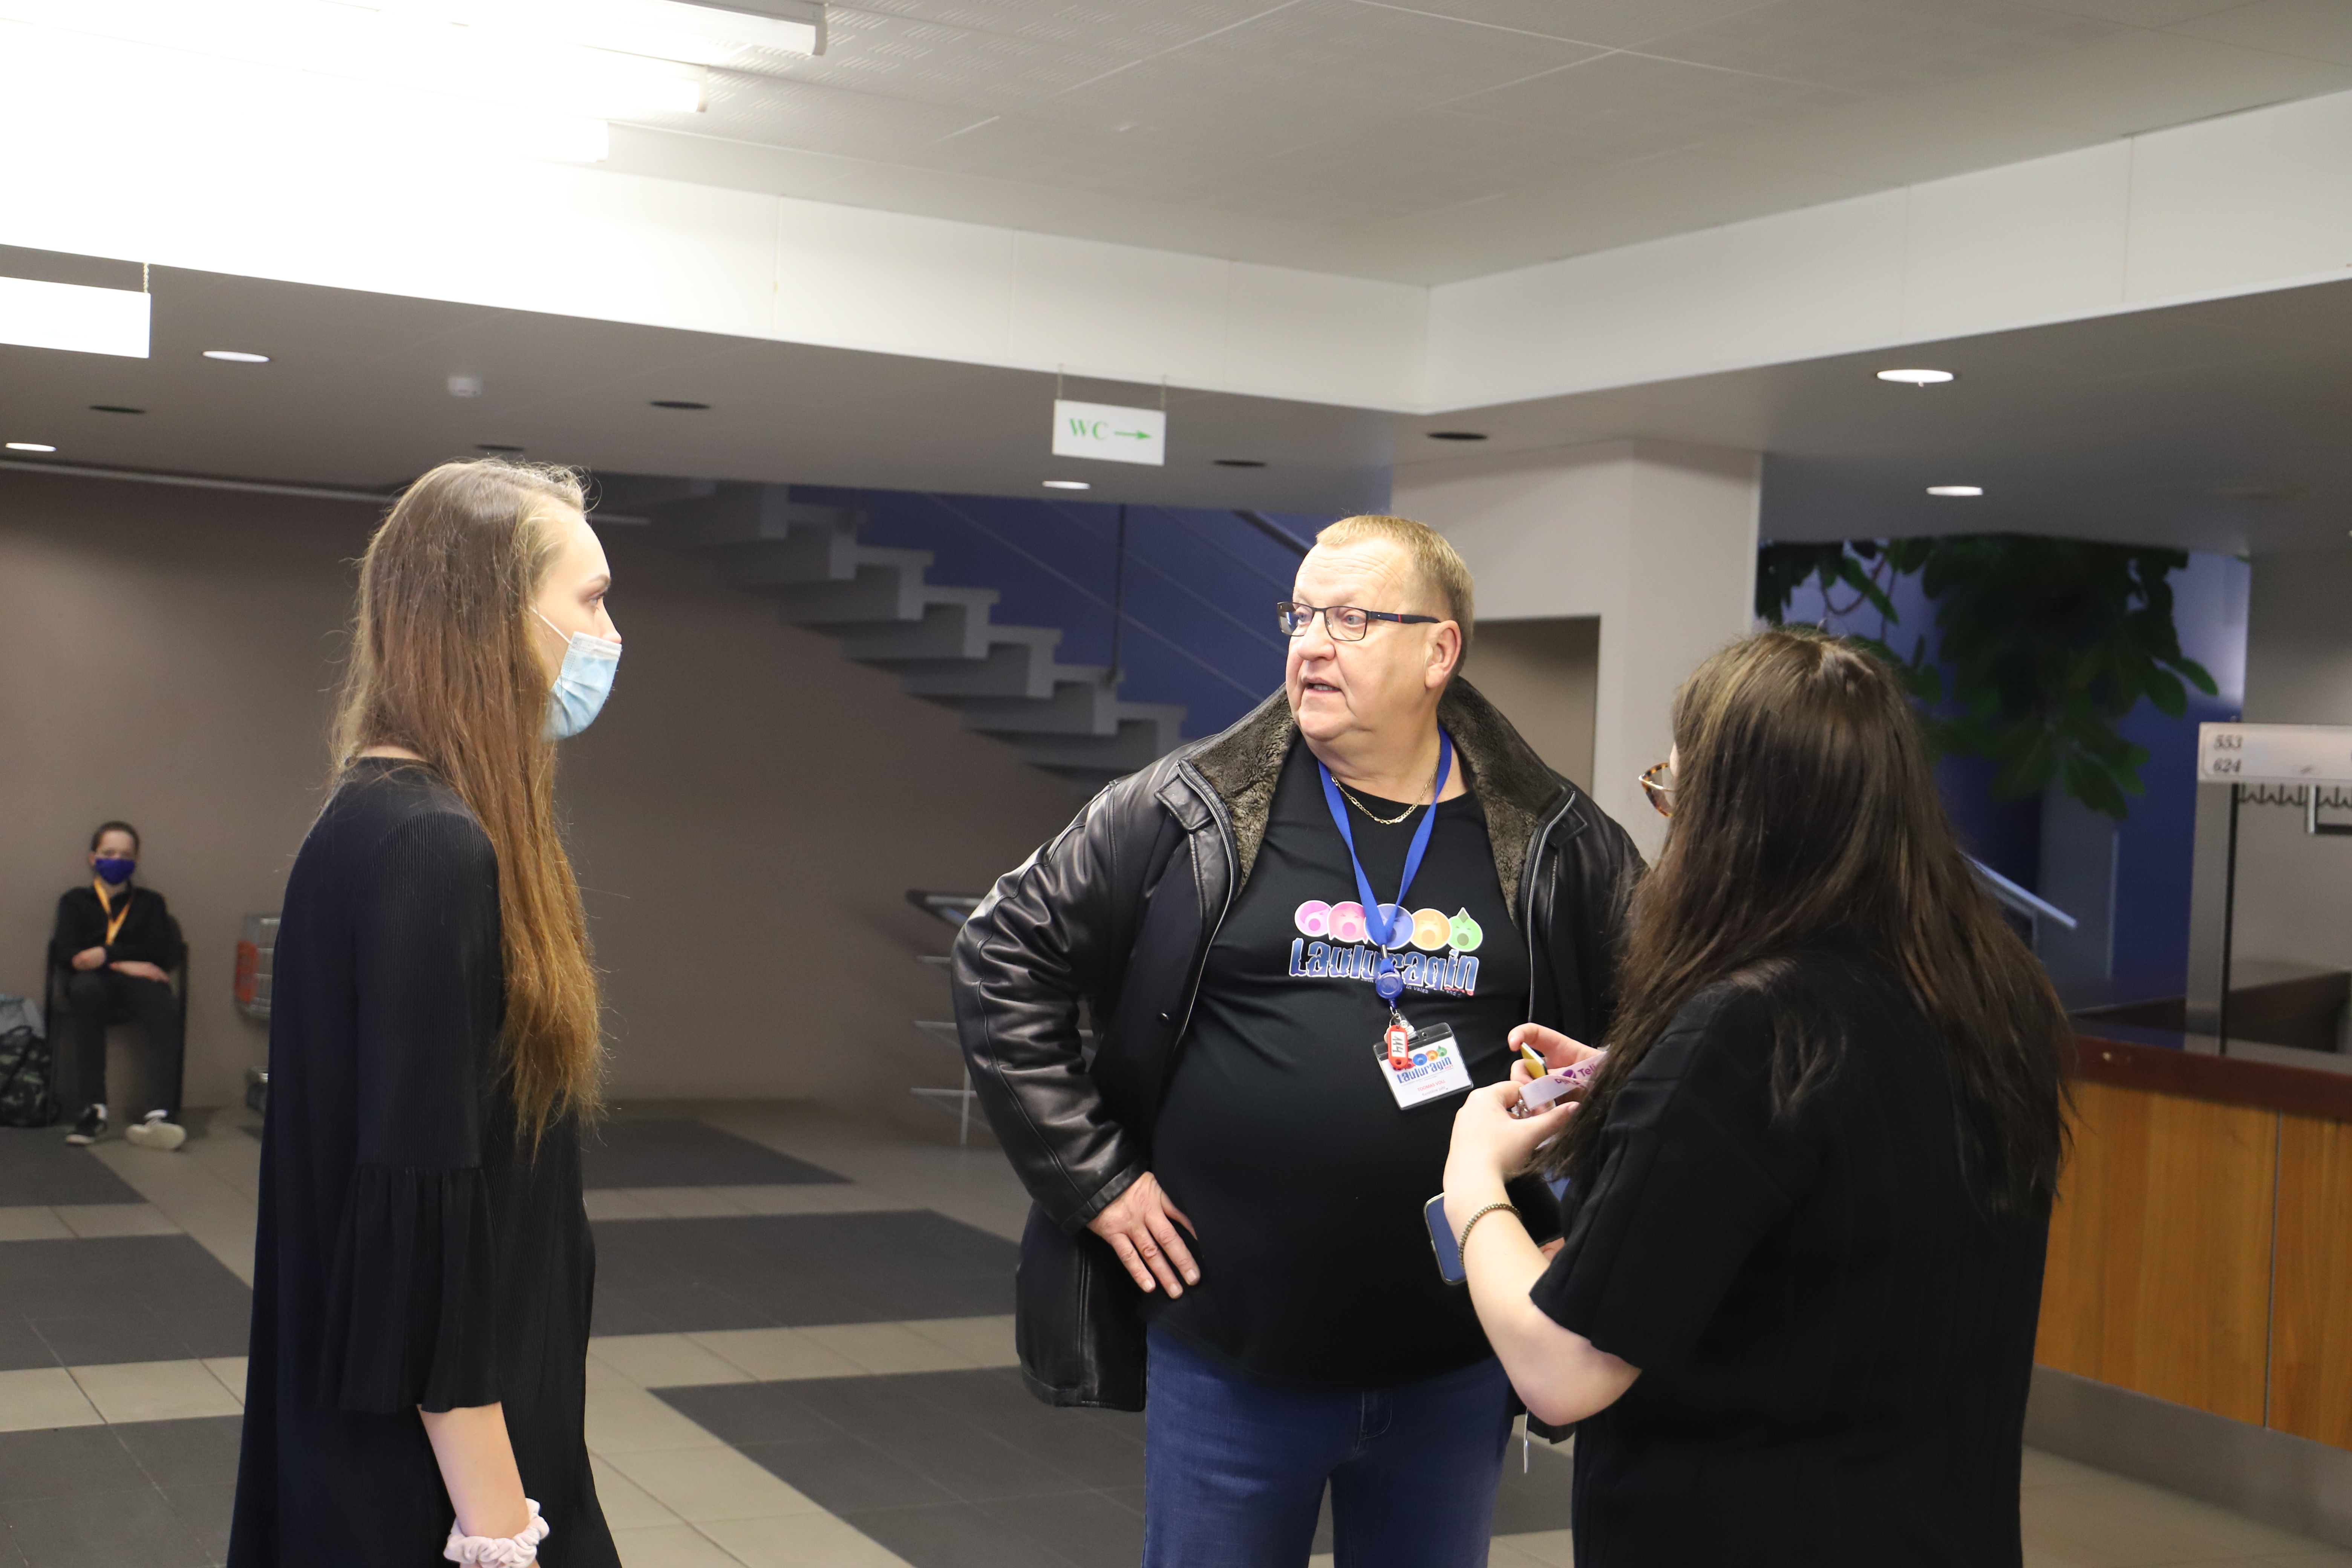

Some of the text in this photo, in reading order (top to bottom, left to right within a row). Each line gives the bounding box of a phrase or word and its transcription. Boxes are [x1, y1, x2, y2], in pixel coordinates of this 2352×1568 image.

[1069, 418, 1108, 441] WC
[2214, 758, 2241, 772] 624
[1397, 1057, 1452, 1084] Lauluragin
[1577, 1064, 1596, 1076] Teli
